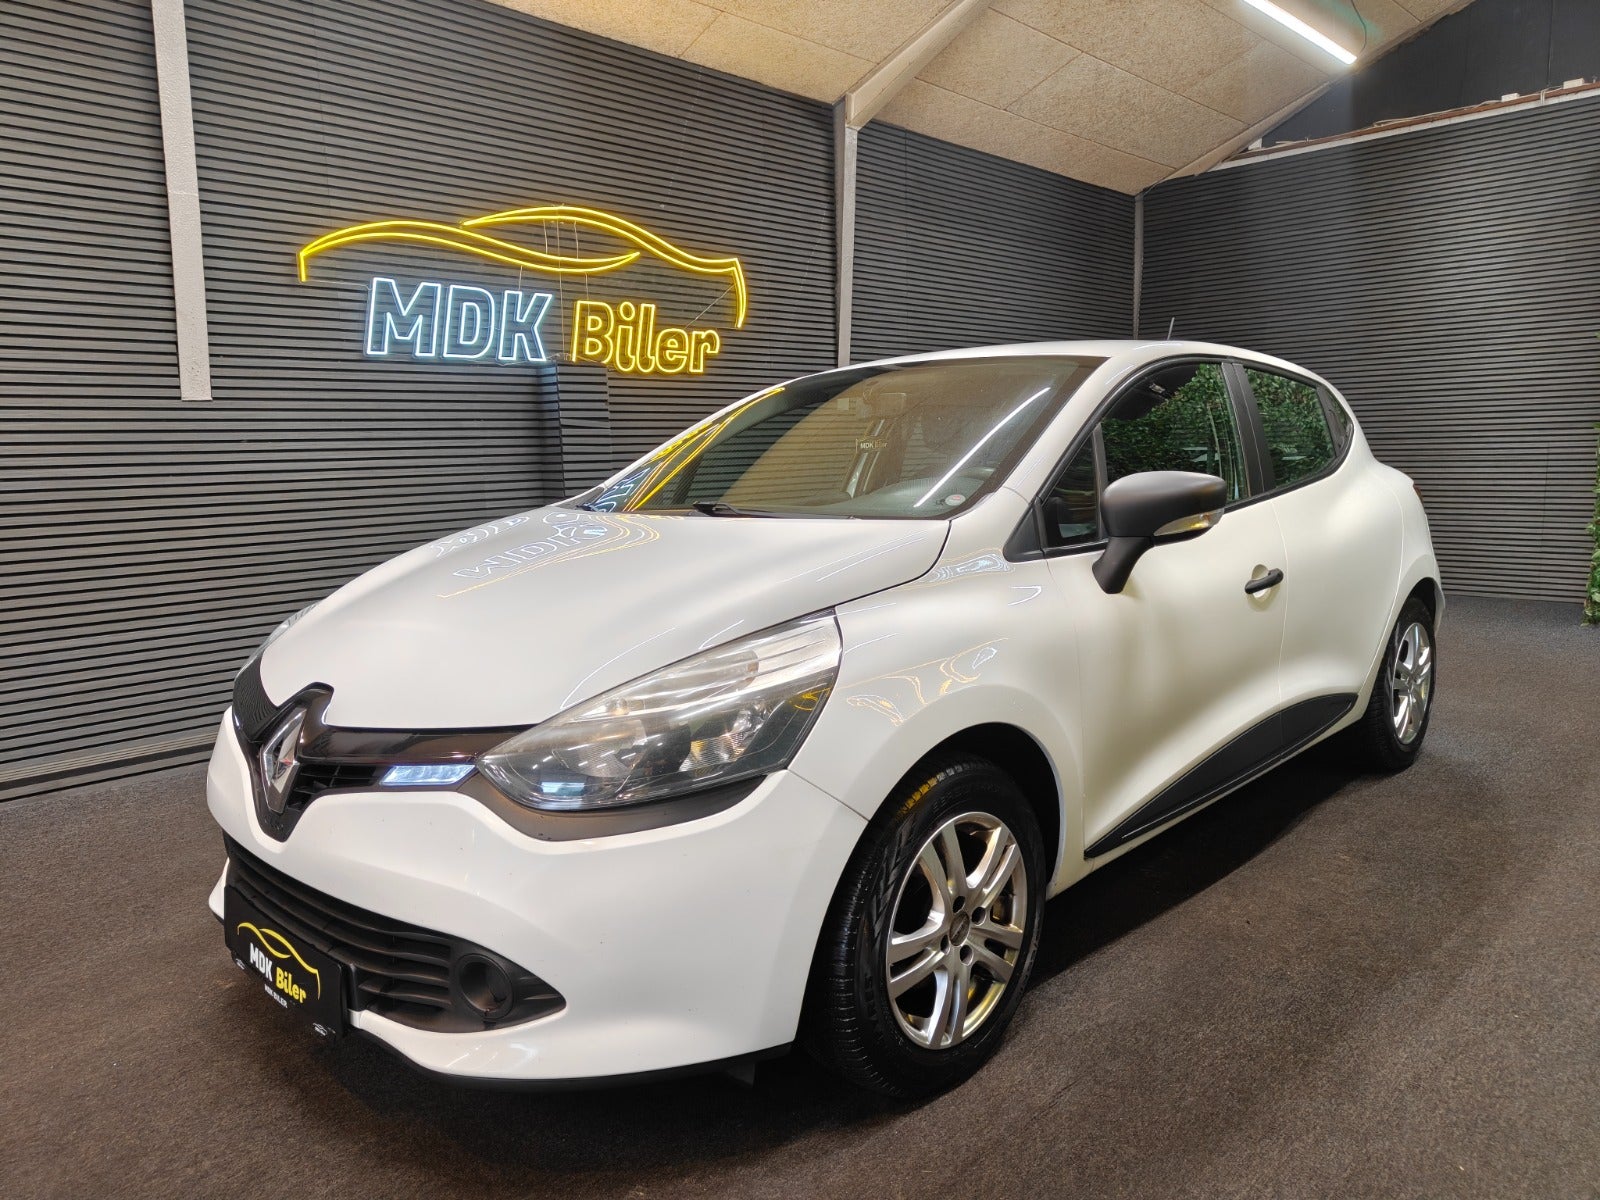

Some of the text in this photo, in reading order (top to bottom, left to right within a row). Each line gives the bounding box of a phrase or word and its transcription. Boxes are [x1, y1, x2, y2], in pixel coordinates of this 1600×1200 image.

[365, 277, 720, 373] MDK Biler
[250, 942, 306, 1003] MDK Biler
